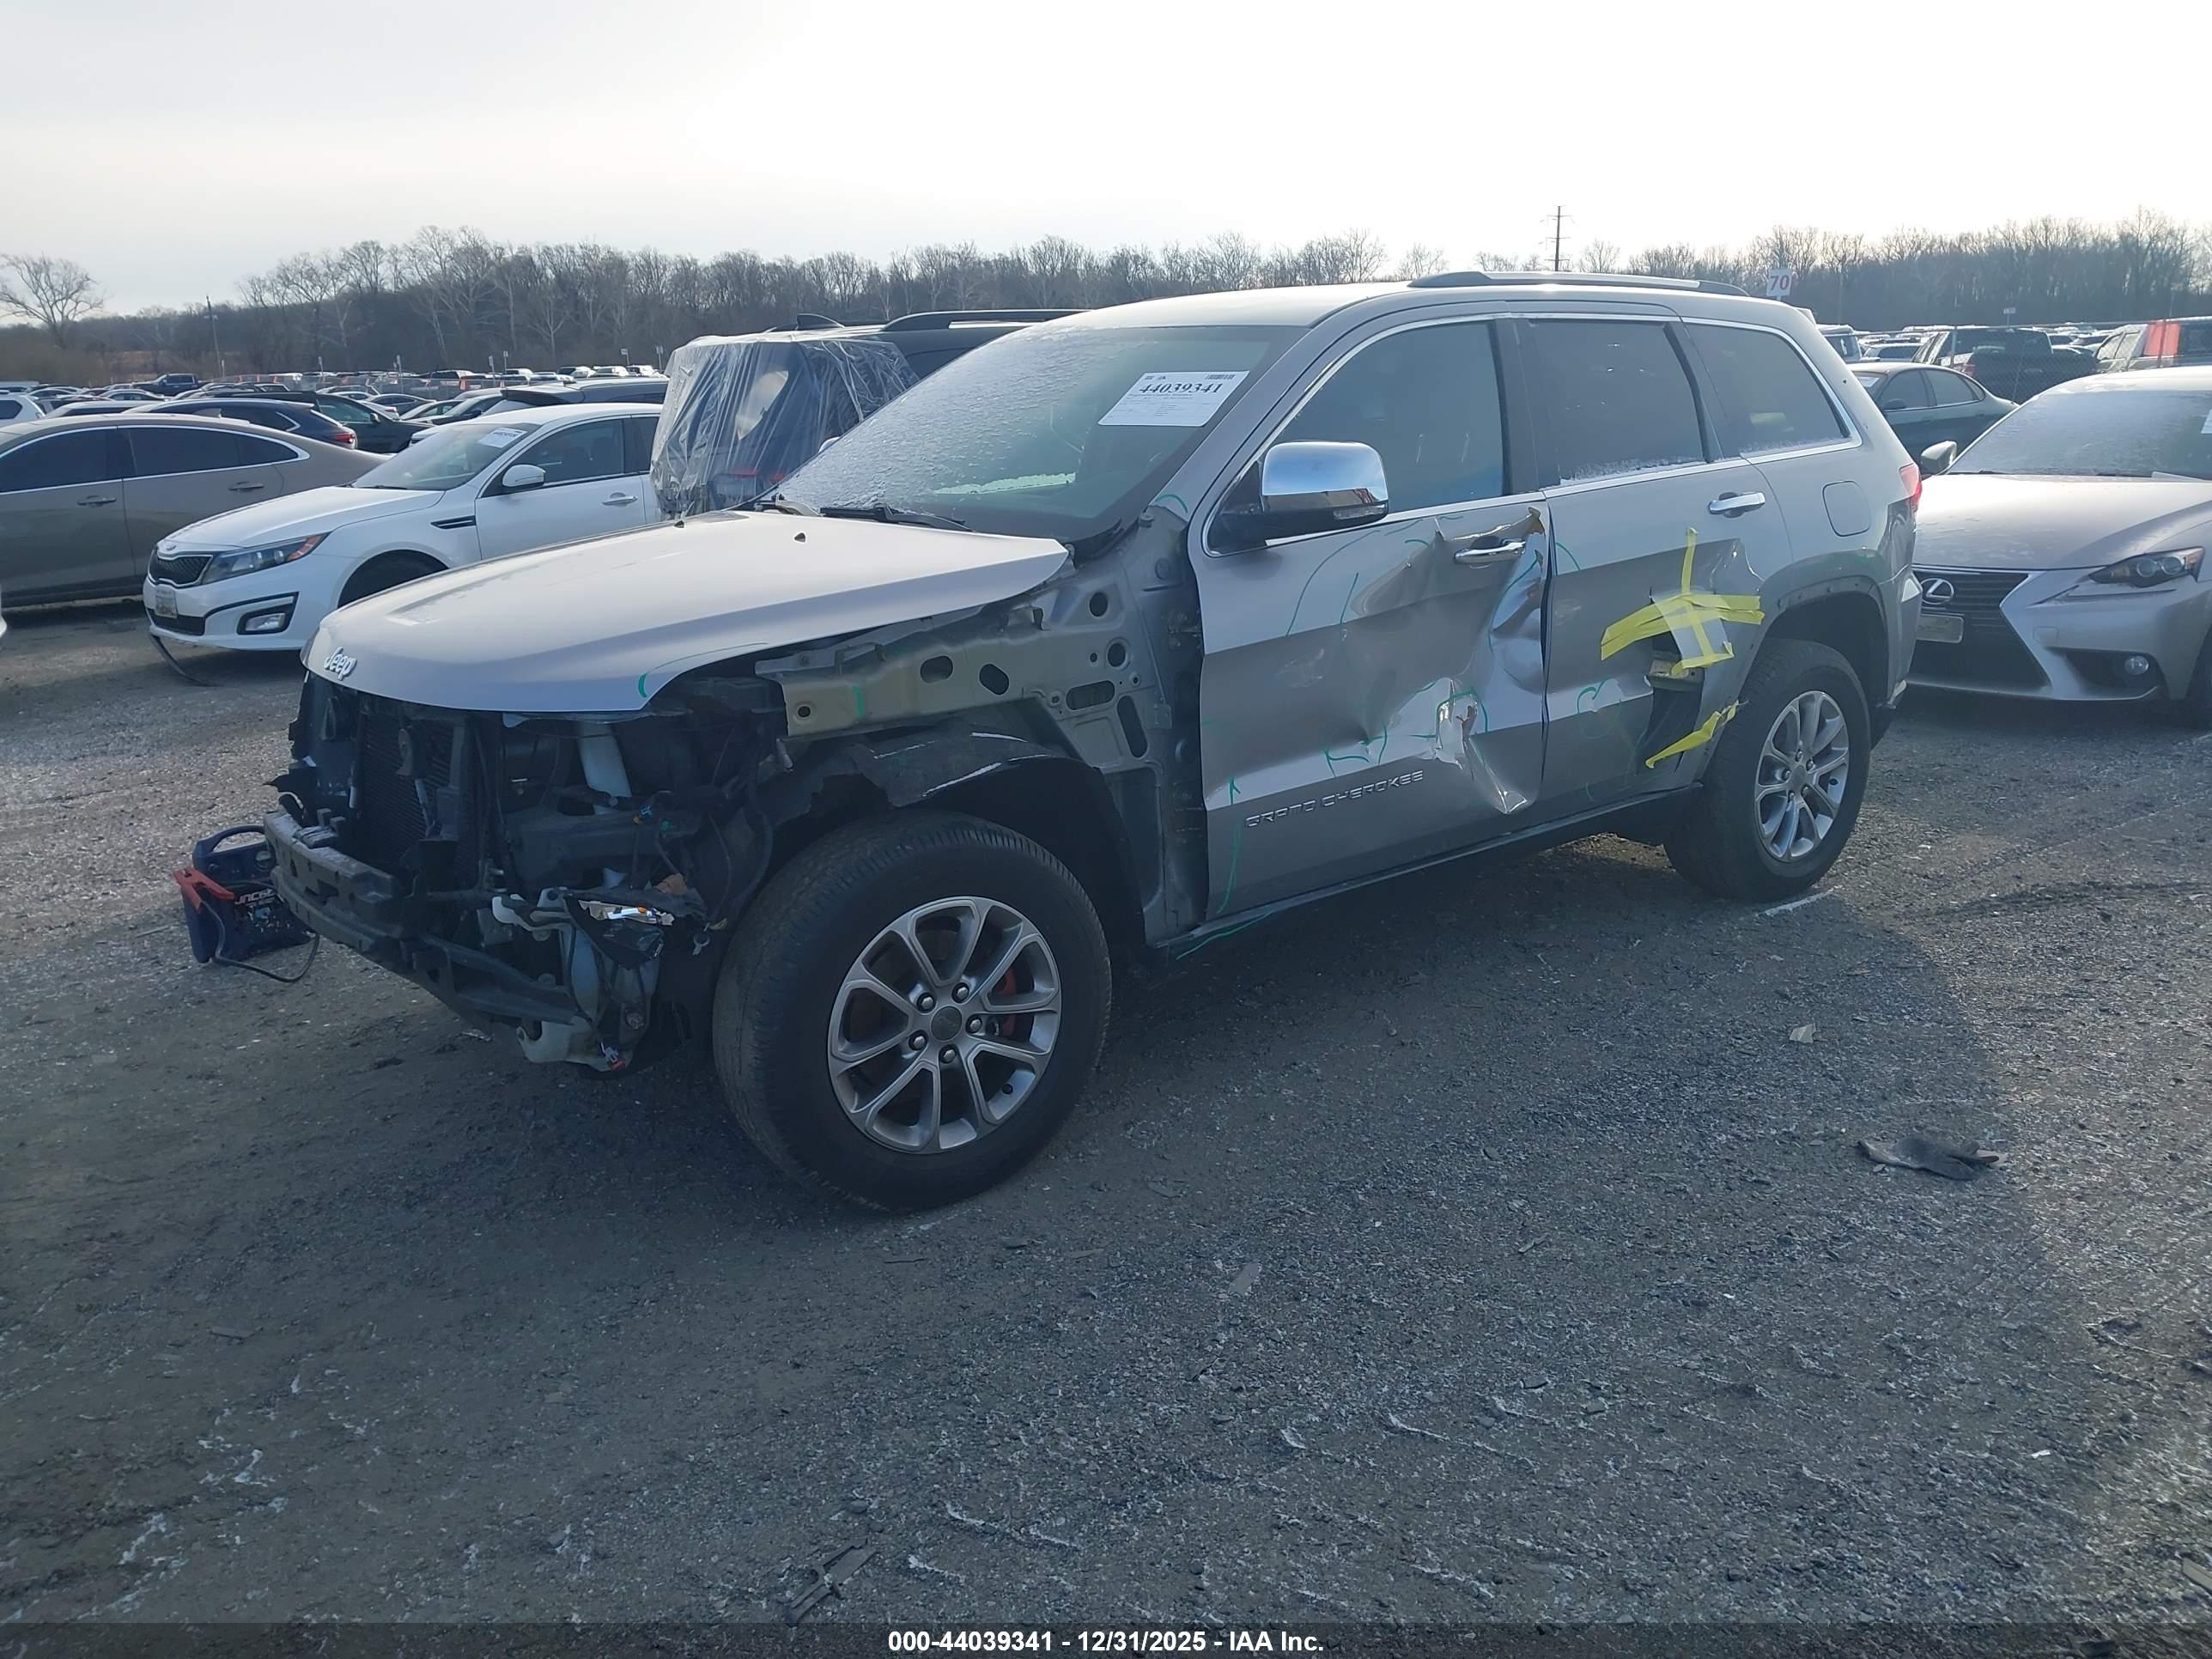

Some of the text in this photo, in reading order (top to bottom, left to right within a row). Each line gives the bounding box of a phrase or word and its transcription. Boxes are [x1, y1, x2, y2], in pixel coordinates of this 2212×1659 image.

[1771, 275, 1790, 290] 70
[1139, 383, 1224, 393] 44039341
[323, 646, 357, 680] Jeep
[1245, 770, 1424, 827] GRAND CHEROKEE
